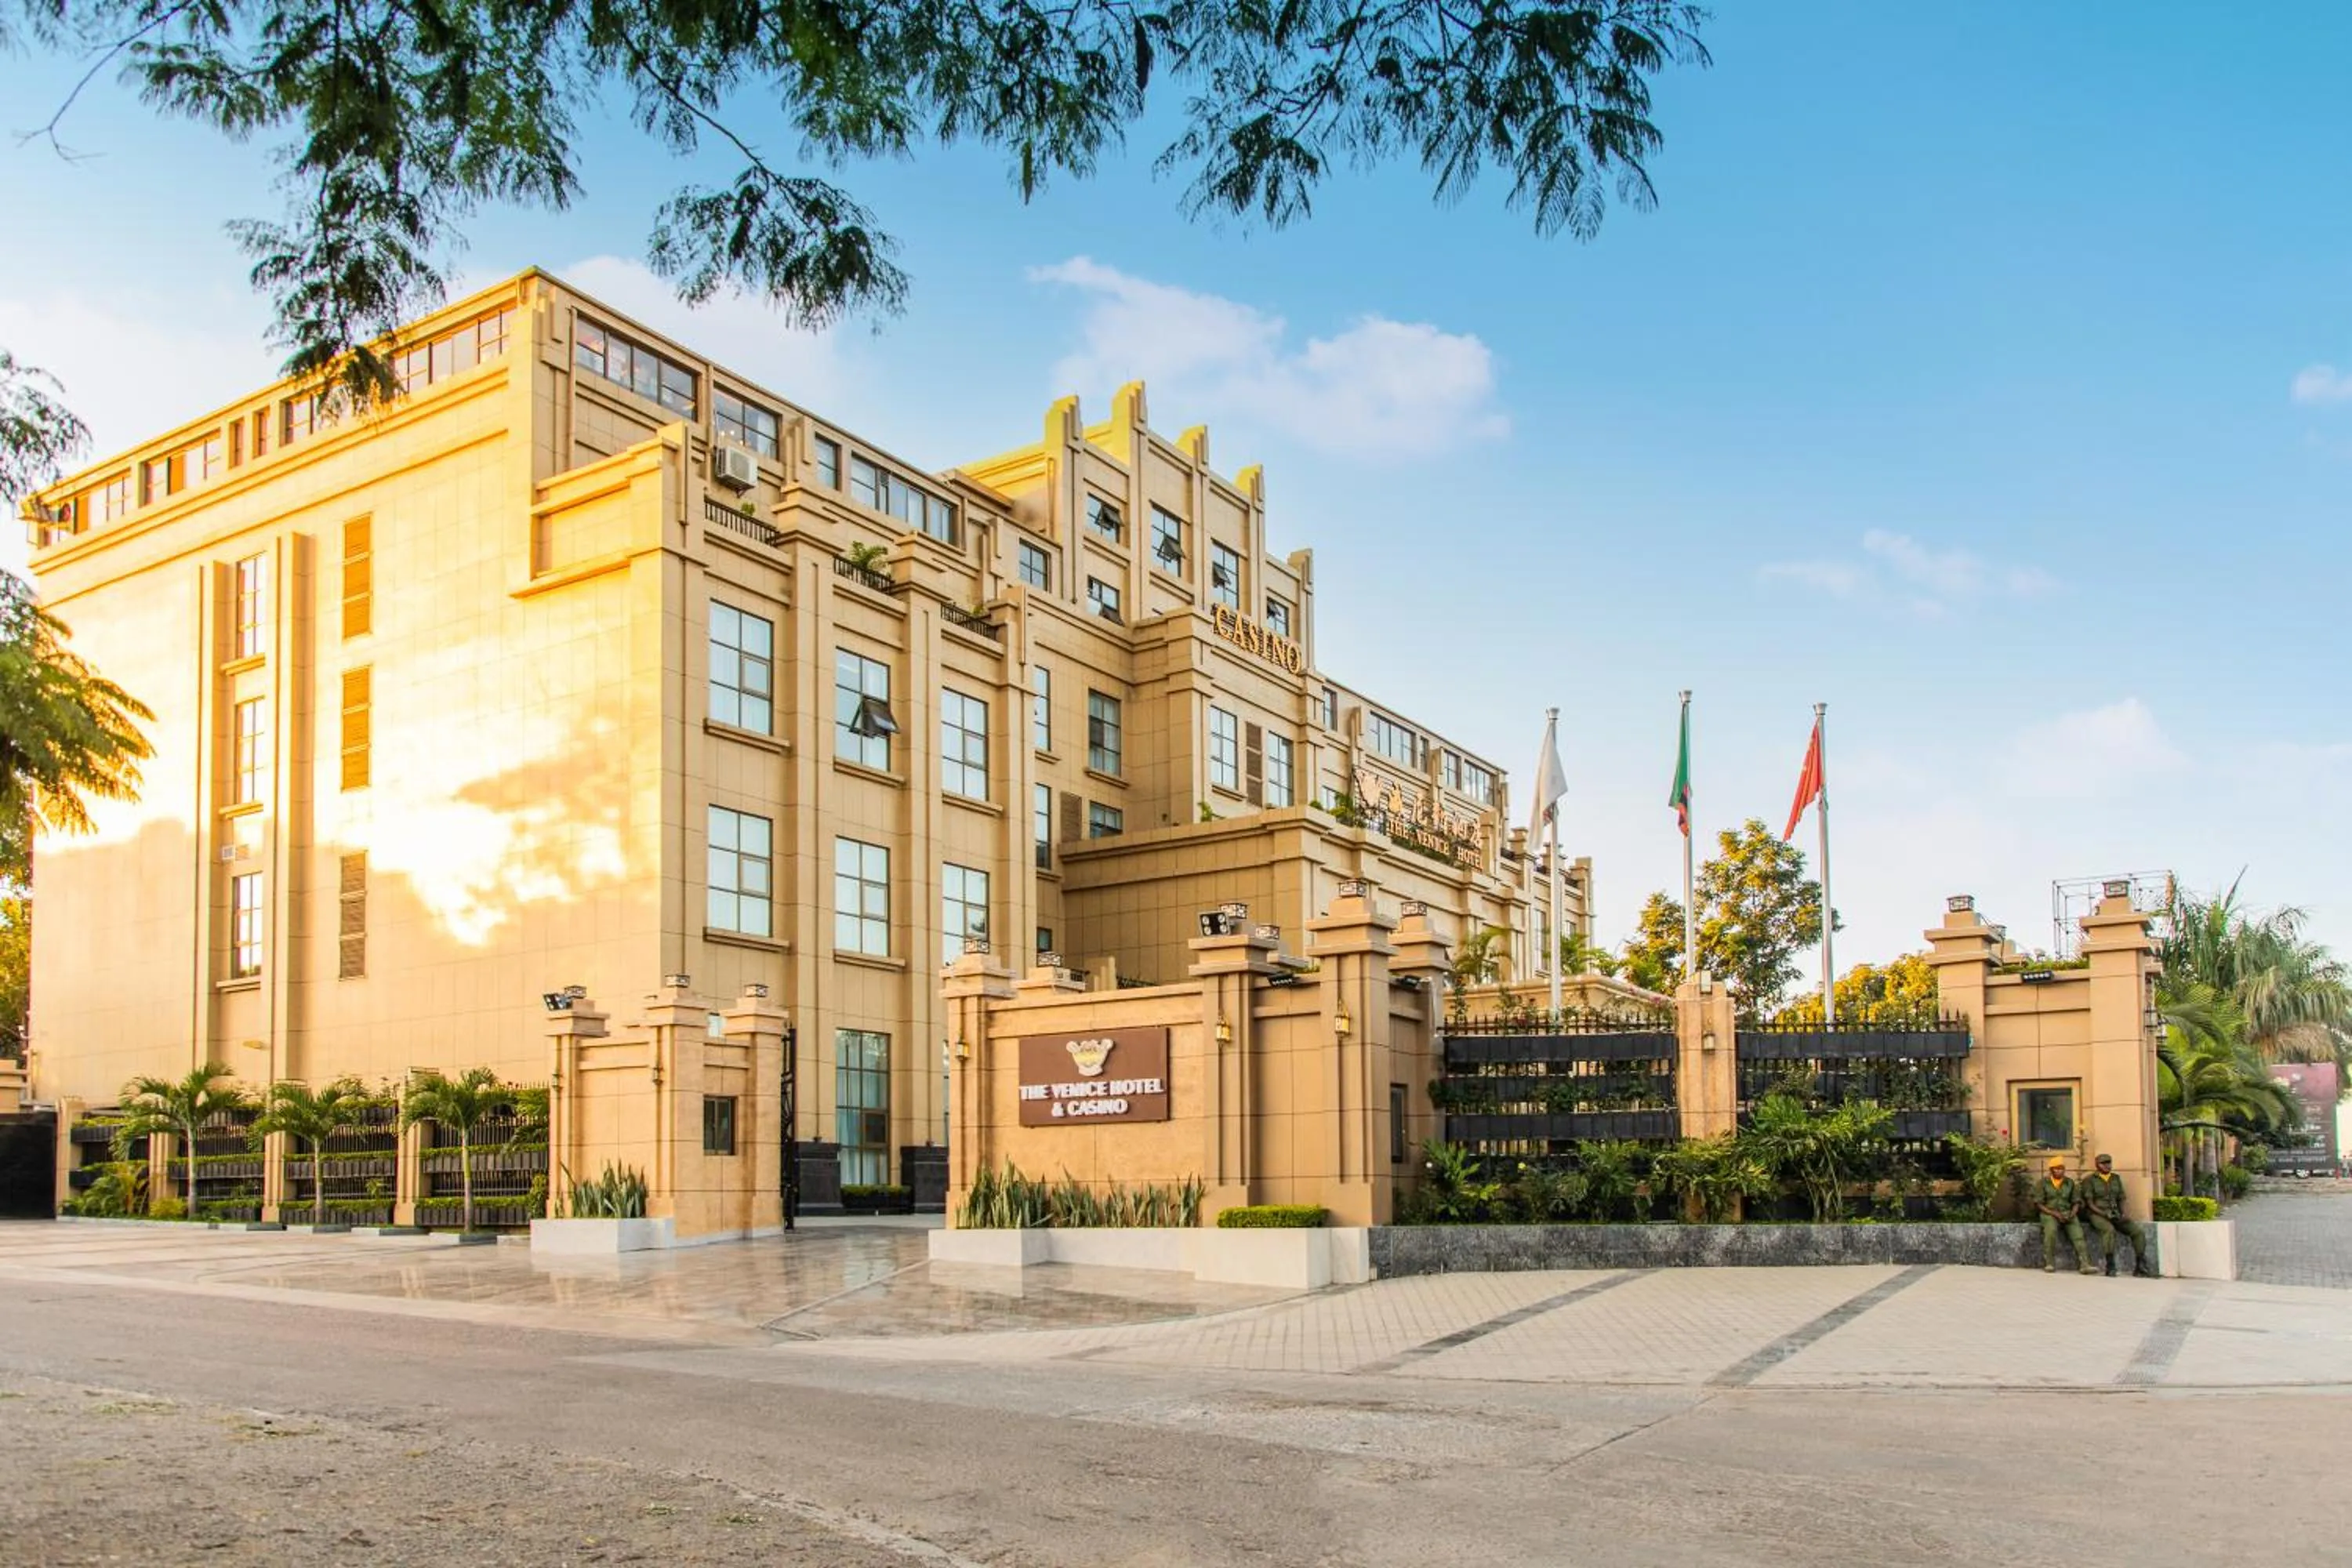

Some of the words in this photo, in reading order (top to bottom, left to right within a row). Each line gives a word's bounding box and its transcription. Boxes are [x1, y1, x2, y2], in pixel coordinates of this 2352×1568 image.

[1216, 603, 1302, 674] CASINO
[1389, 820, 1410, 840] THE
[1417, 829, 1450, 856] VENICE
[1458, 846, 1483, 872] HOTEL
[1020, 1084, 1048, 1100] THE
[1052, 1081, 1109, 1098] VENICE
[1109, 1078, 1164, 1096] HOTEL
[1051, 1102, 1065, 1116] &
[1067, 1098, 1128, 1116] CASINO
